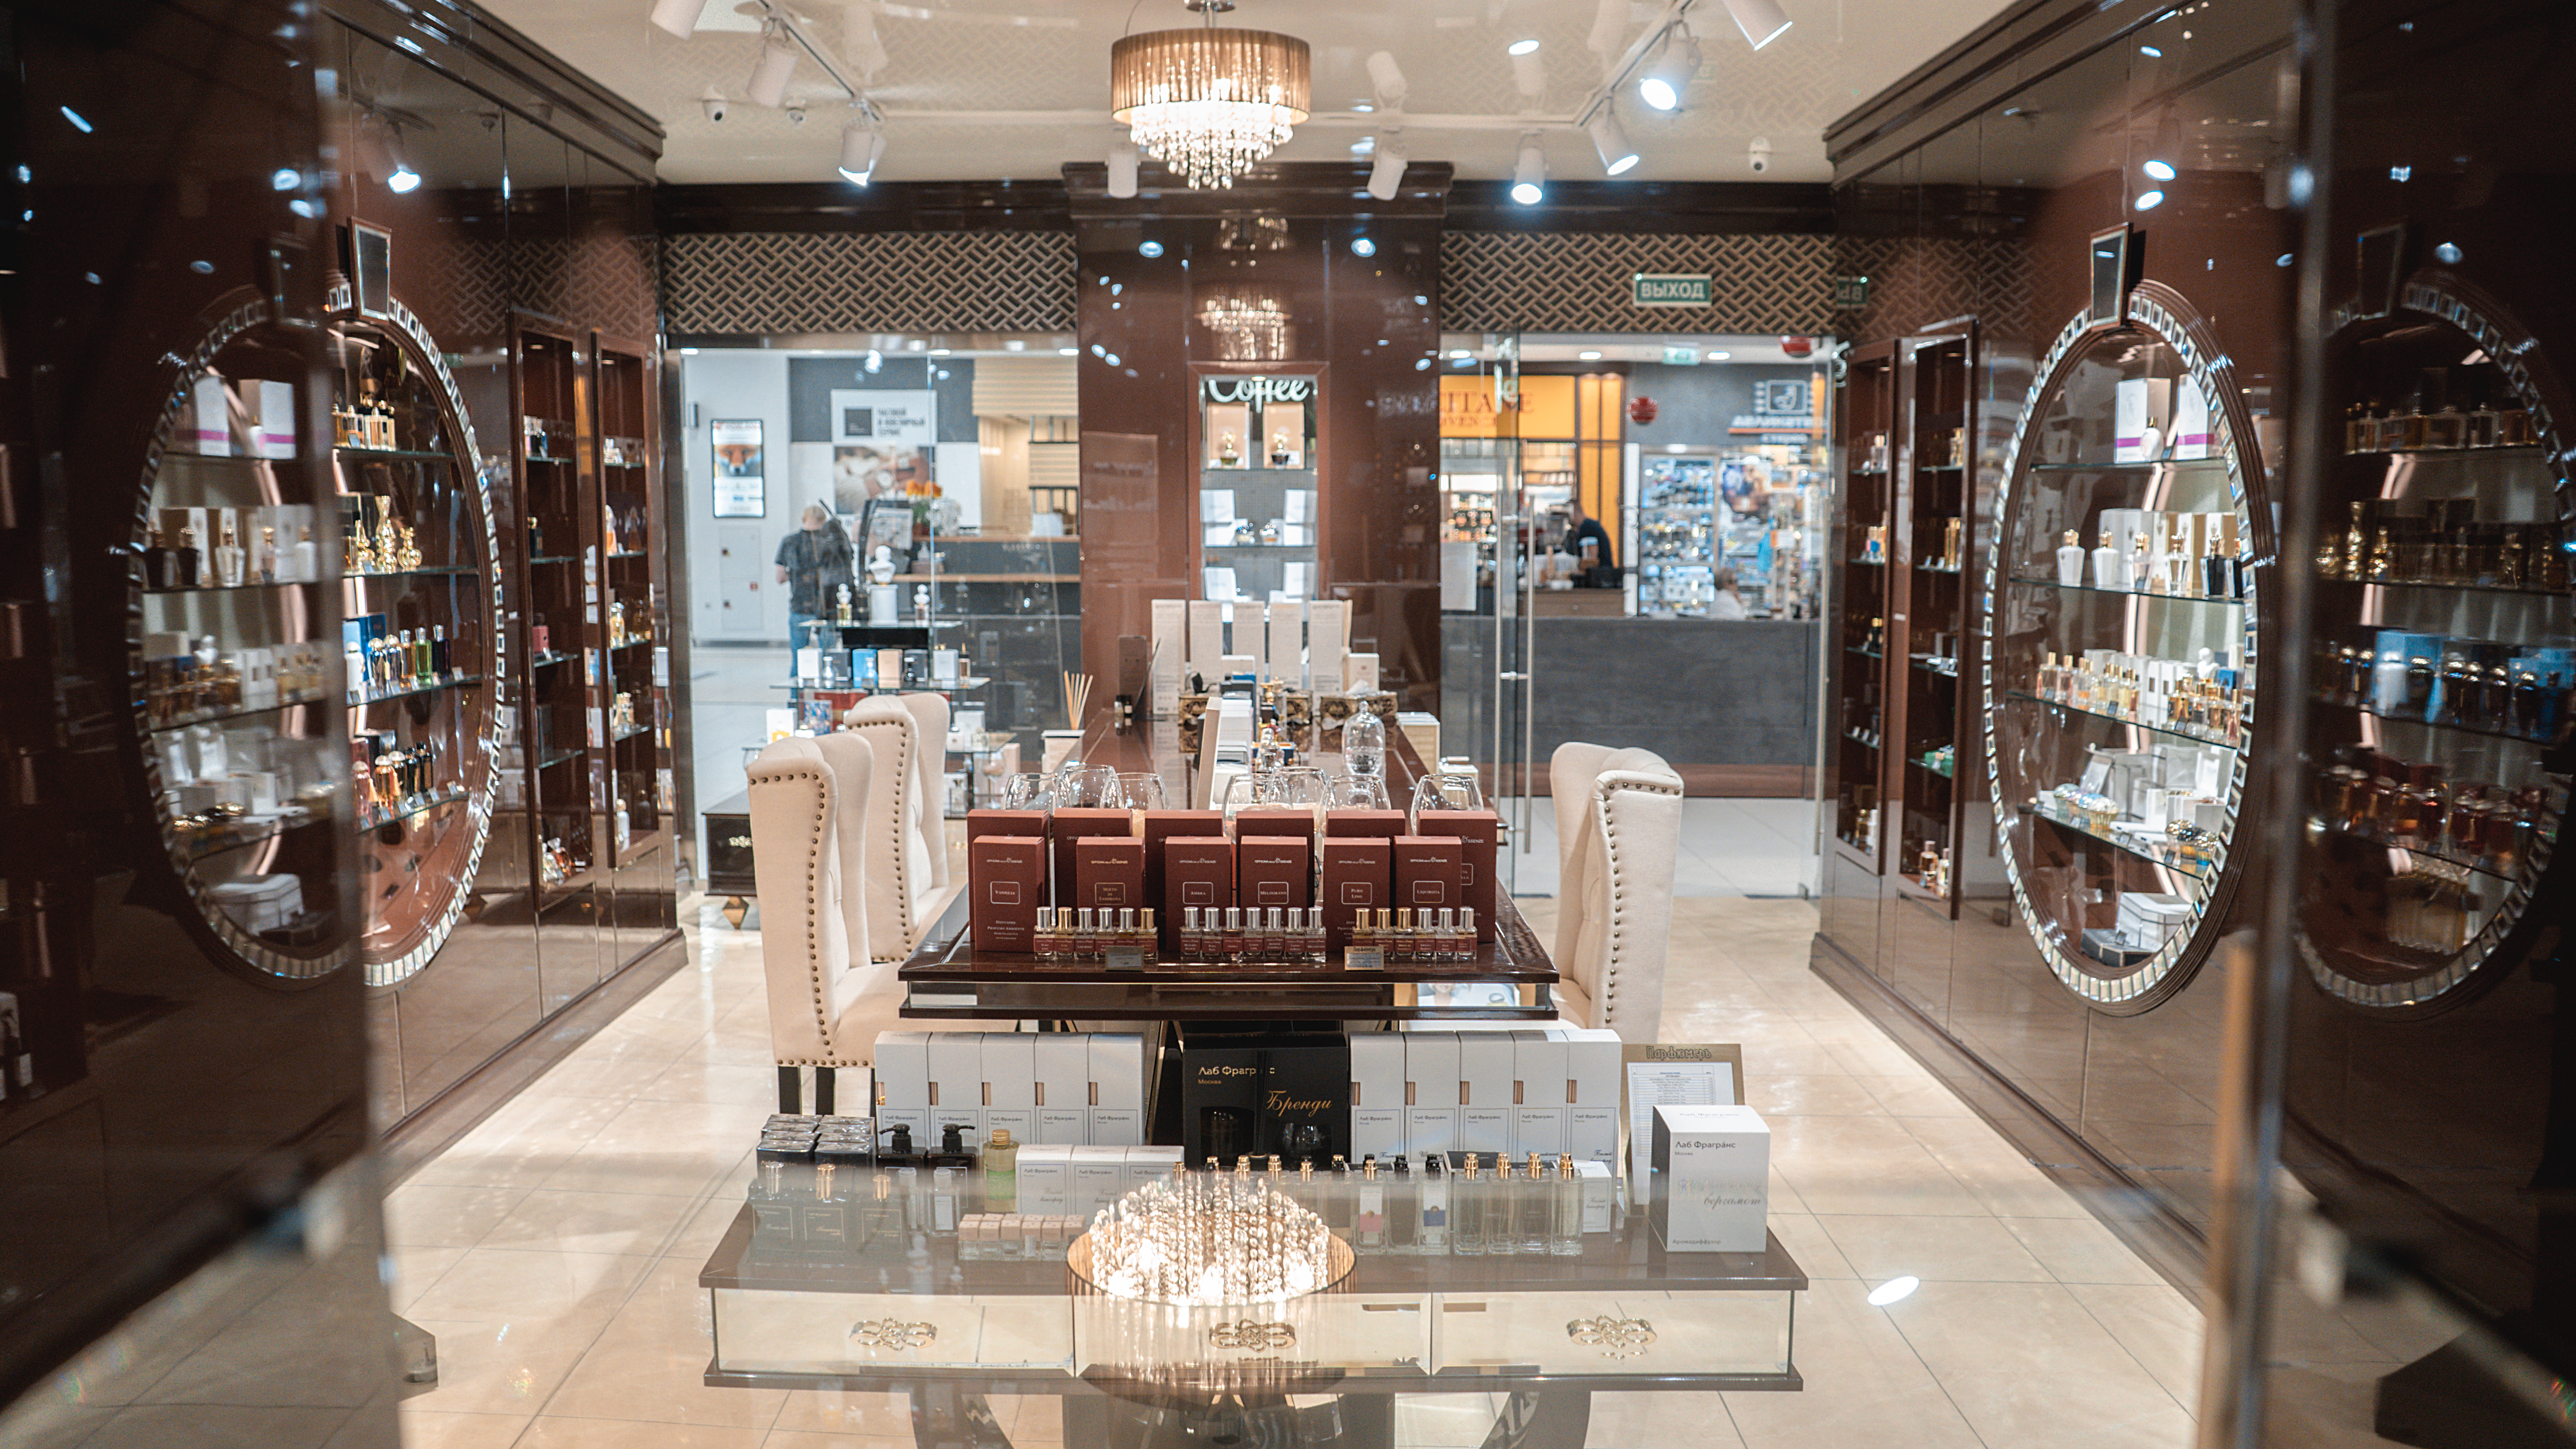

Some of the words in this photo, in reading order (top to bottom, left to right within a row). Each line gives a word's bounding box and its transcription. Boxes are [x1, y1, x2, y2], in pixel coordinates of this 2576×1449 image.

[1641, 282, 1705, 299] ВЫХОД
[1646, 1046, 1712, 1061] Парфюмеръ
[1199, 1066, 1219, 1075] Лаб
[1266, 1090, 1332, 1117] Бренди
[1704, 1194, 1761, 1210] бергамот
